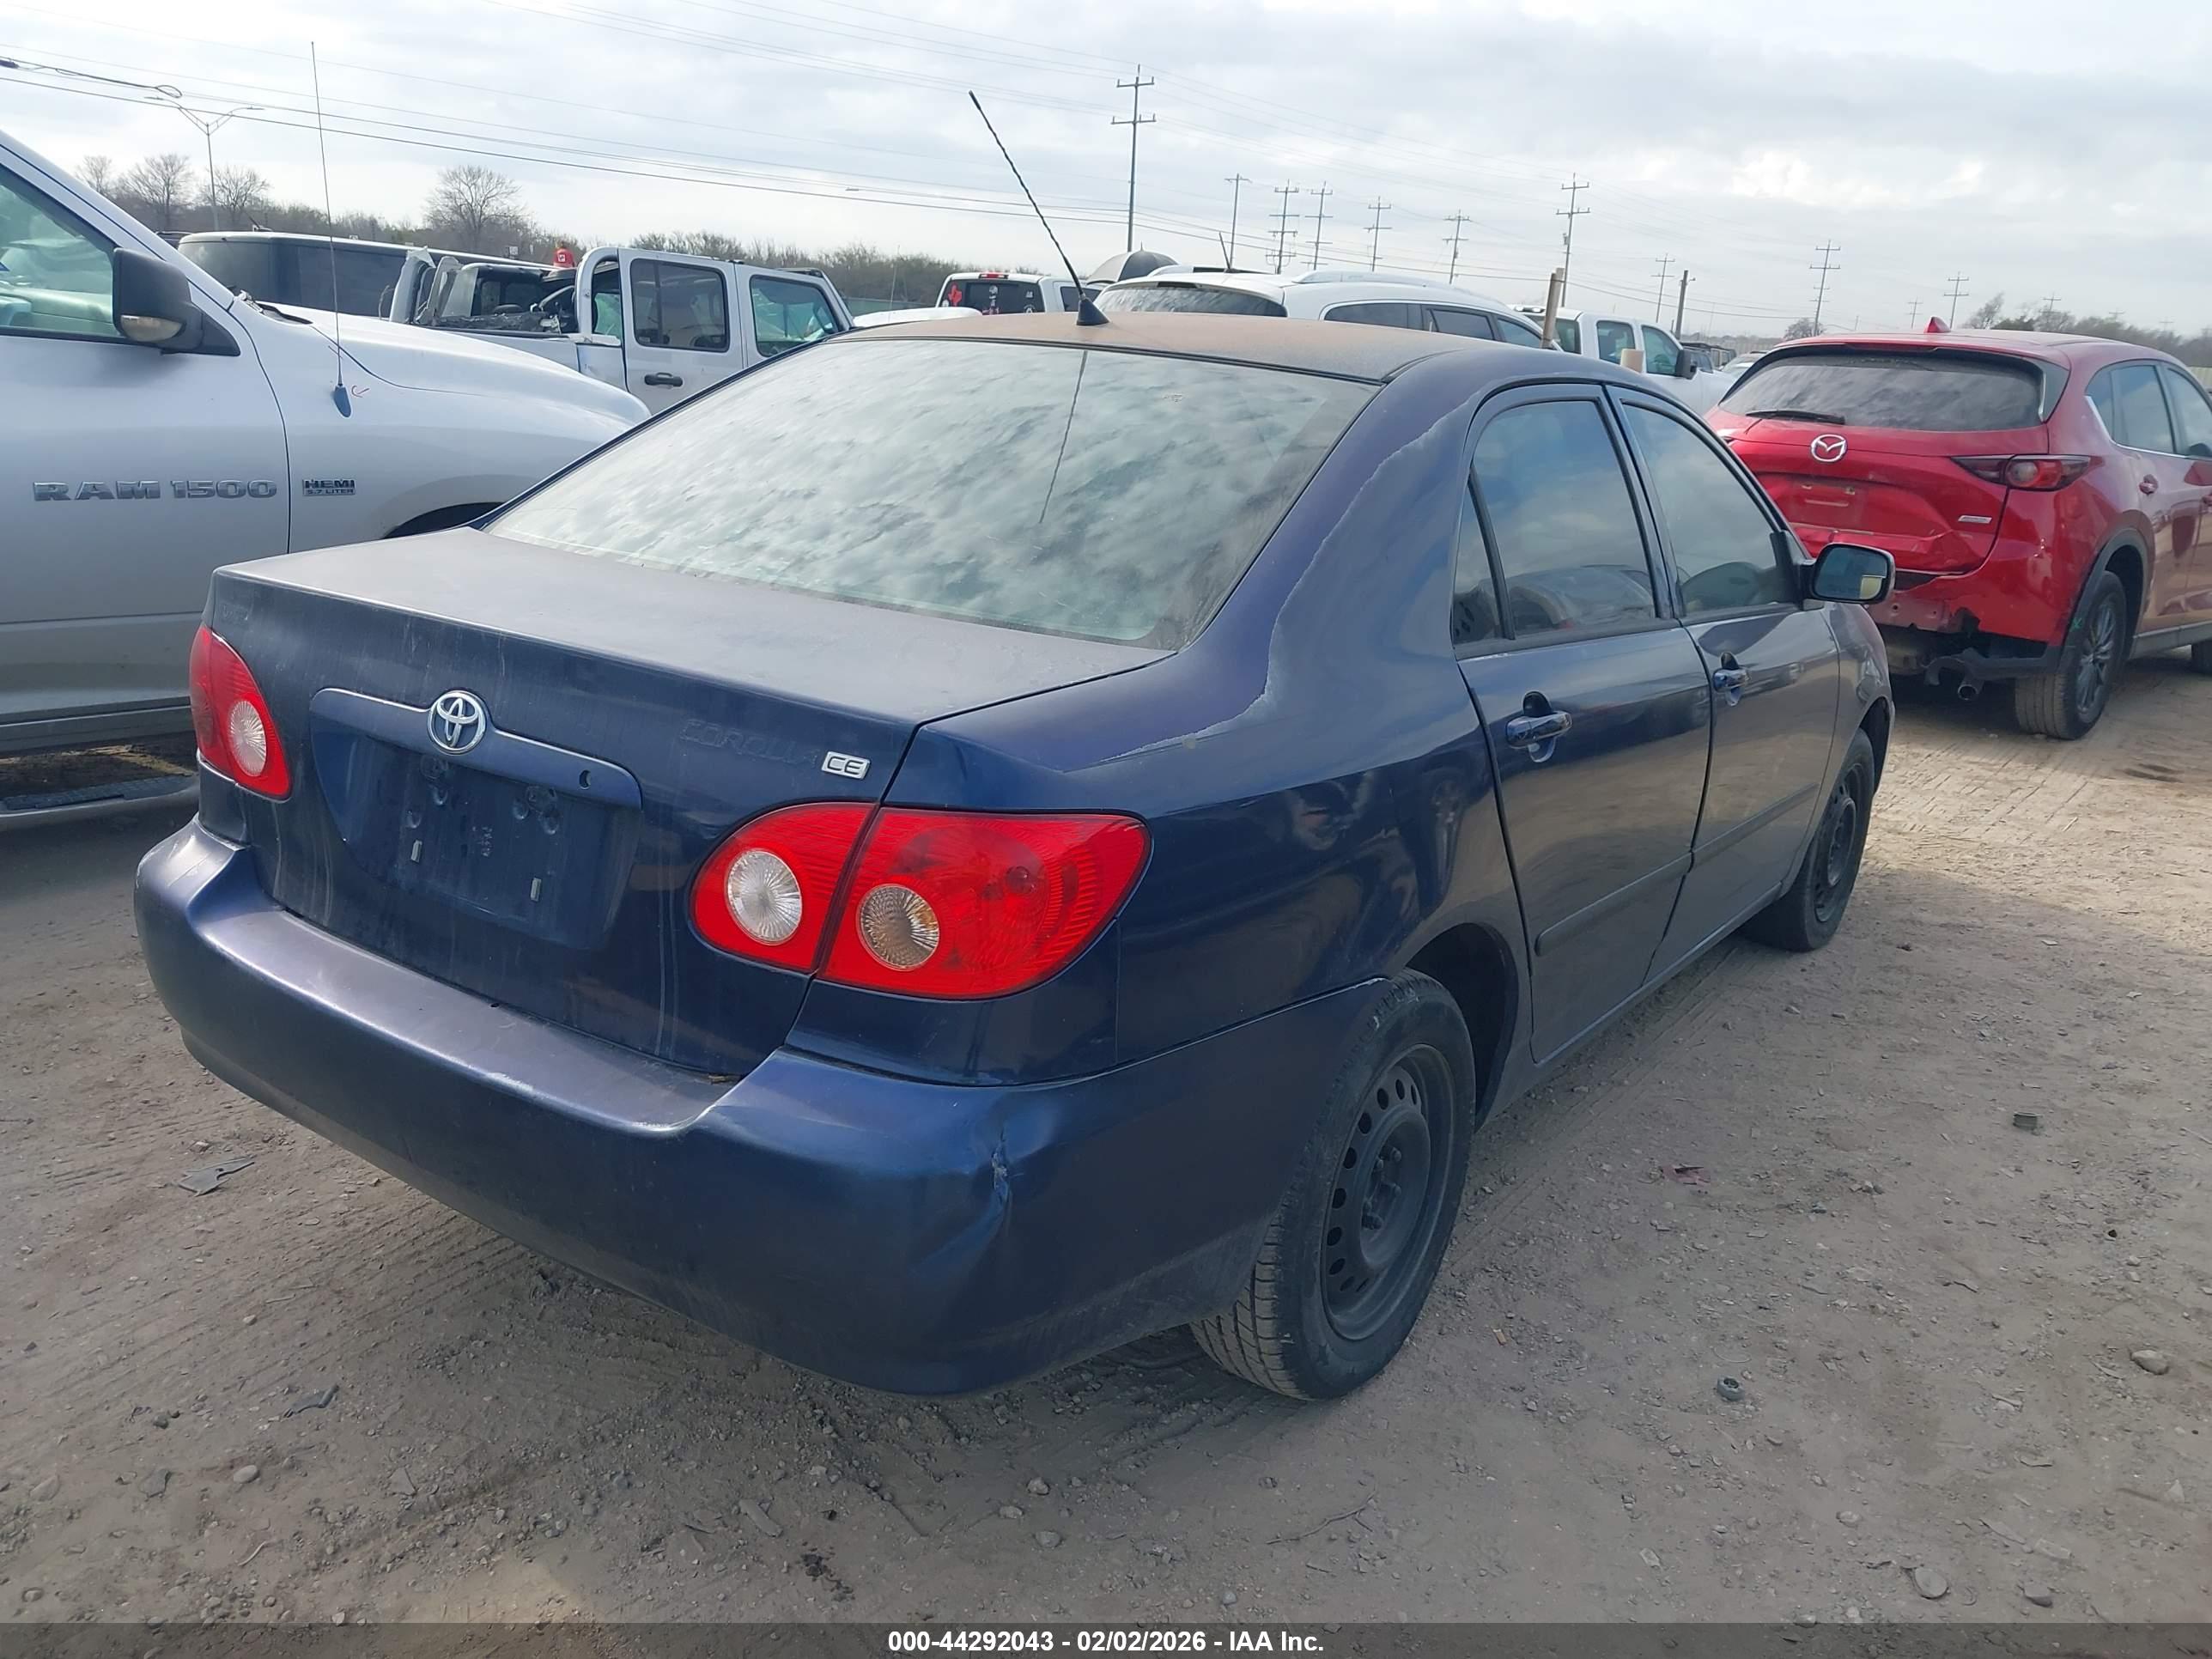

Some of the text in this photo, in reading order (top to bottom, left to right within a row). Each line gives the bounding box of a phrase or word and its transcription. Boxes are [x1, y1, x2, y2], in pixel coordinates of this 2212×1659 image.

[33, 479, 277, 501] RAM 1500
[305, 479, 356, 489] HEMI
[826, 756, 865, 775] CE
